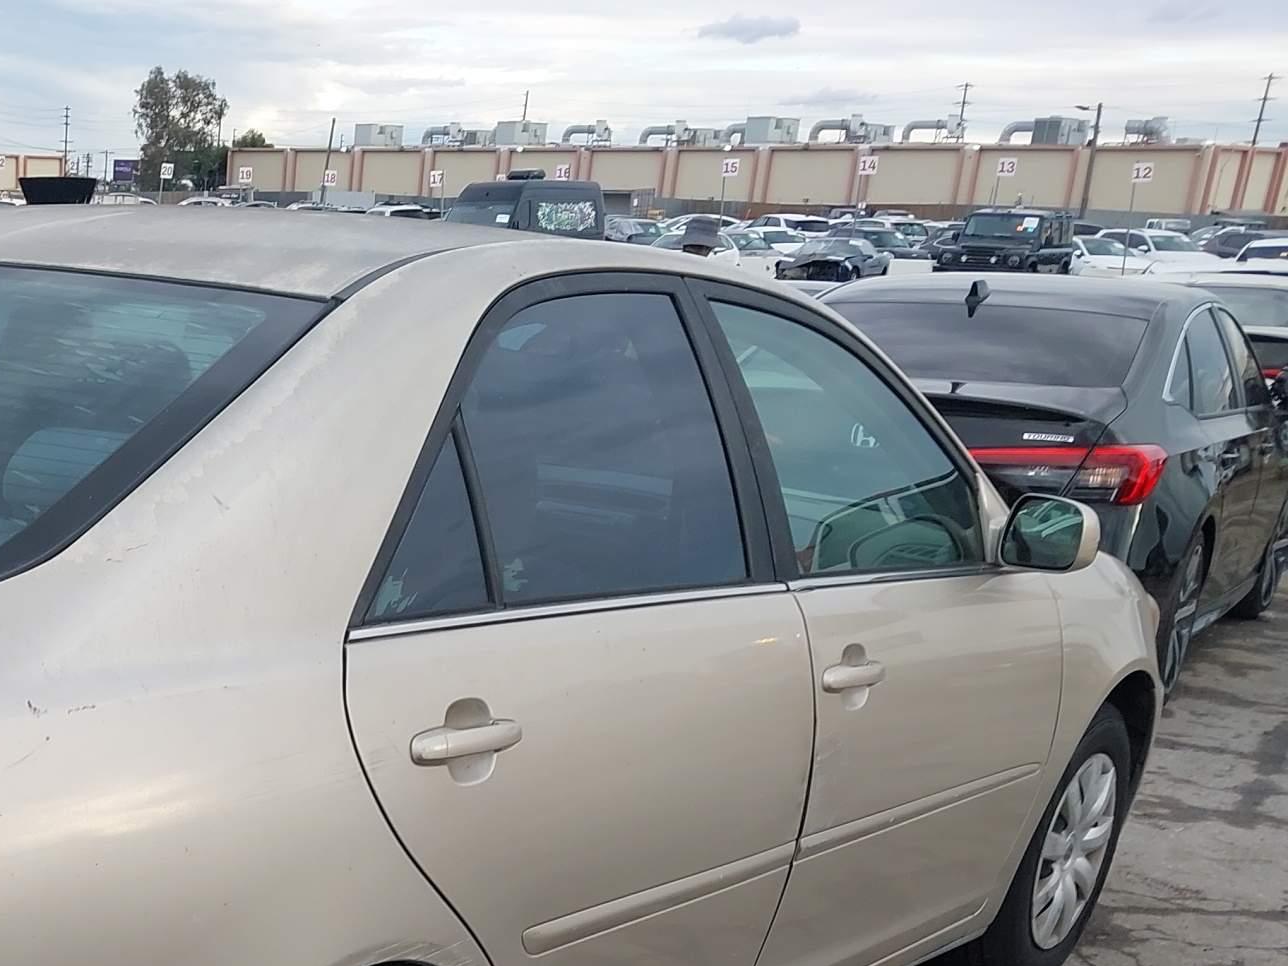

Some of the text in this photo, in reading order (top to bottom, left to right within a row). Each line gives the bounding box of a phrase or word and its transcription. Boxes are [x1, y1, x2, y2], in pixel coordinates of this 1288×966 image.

[162, 166, 172, 175] 20
[723, 162, 737, 173] 15
[860, 160, 876, 171] 14
[998, 162, 1015, 173] 13
[241, 170, 251, 179] 19
[326, 173, 336, 183] 18
[557, 168, 570, 178] 16
[1134, 167, 1152, 179] 12
[432, 174, 443, 184] 17
